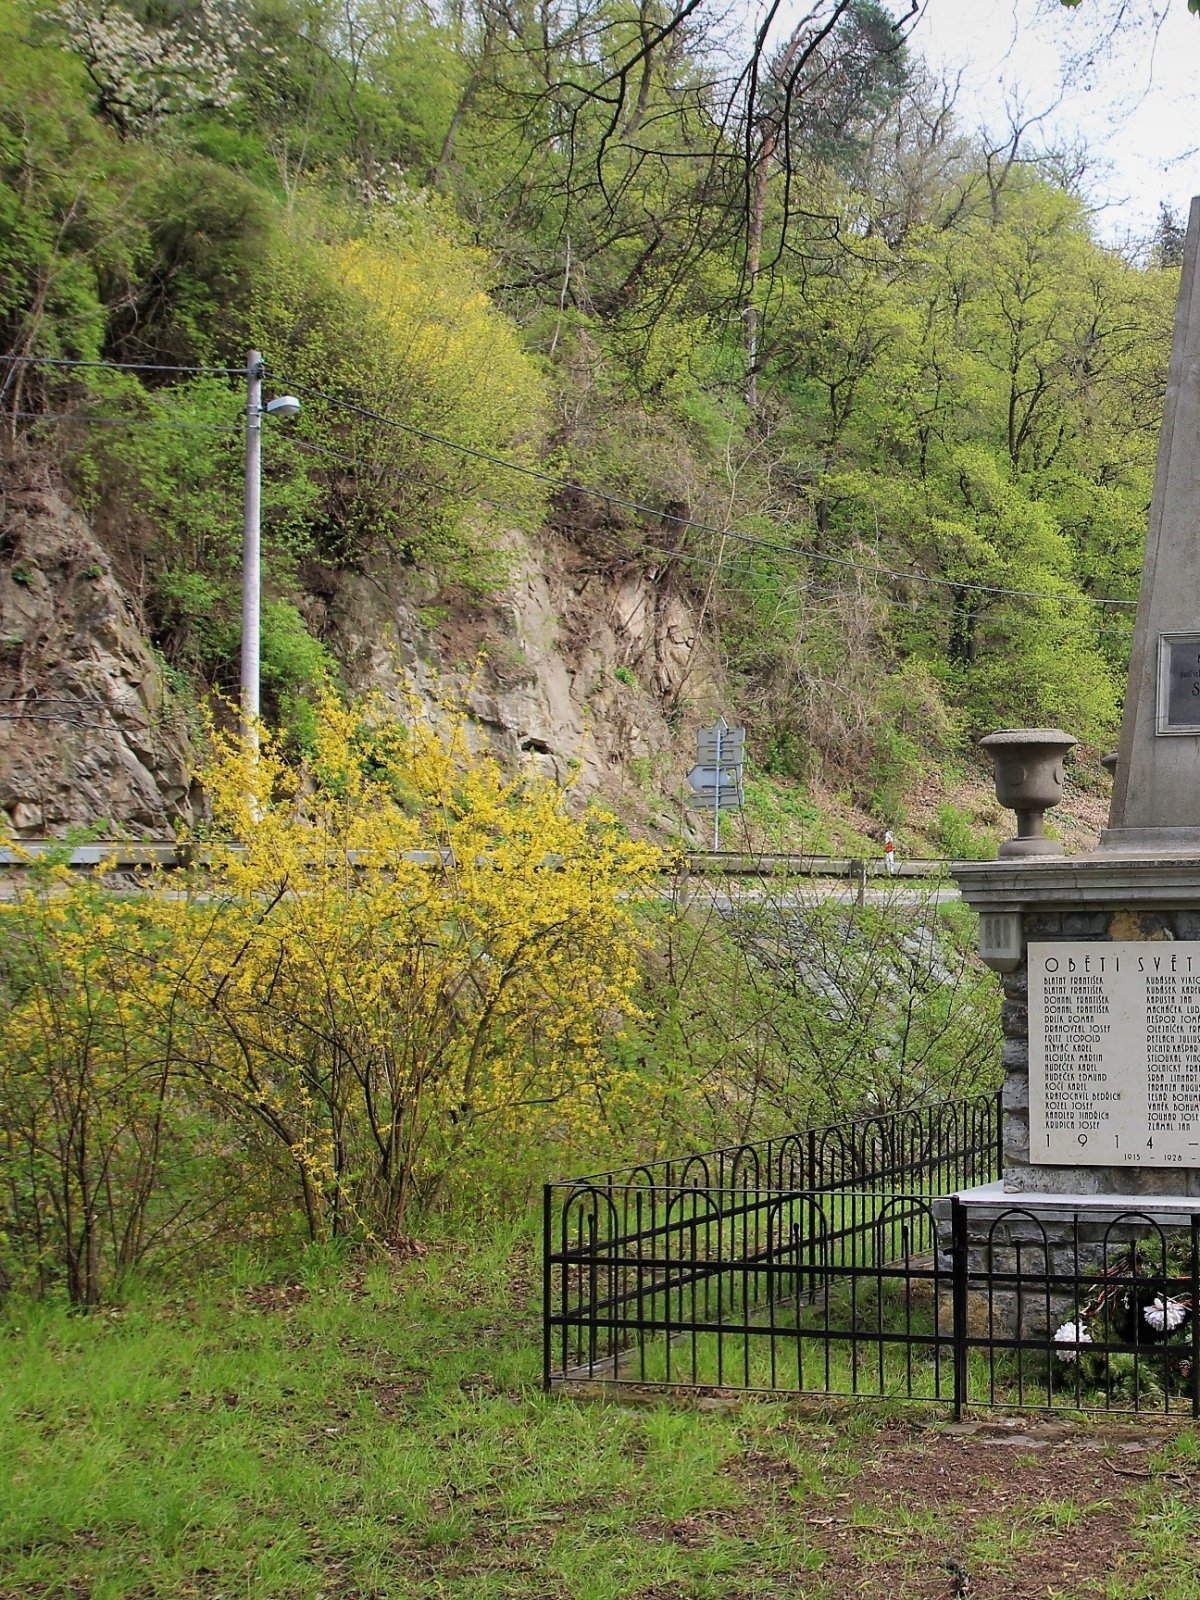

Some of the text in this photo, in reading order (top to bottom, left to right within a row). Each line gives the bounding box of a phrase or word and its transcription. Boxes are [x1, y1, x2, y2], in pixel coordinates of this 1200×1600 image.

[1045, 955, 1119, 972] OBĚTI
[1071, 976, 1103, 984] FRANTIŠEK
[1071, 986, 1103, 994] FRANTIŠEK
[1045, 995, 1109, 1004] DOHNAL FRANTIŠEK
[1147, 996, 1175, 1004] KAPUSTA
[1077, 1005, 1109, 1013] FRANTIŠEK
[1045, 1015, 1063, 1023] DRLÍK
[1147, 1015, 1175, 1023] NEŠPOR
[1147, 1024, 1184, 1033] OLEJNÍČEK
[1180, 1035, 1200, 1043] JULIUS
[1173, 1044, 1198, 1052] KAŠPAR
[1045, 1053, 1075, 1061] HLOUŠEK
[1045, 1063, 1073, 1071] HUDEČEK
[1148, 1064, 1181, 1072] SOLNICKÝ
[1045, 1072, 1074, 1081] HUDEČEK
[1045, 1092, 1120, 1100] KRATOCHVÍL BEDŘICH
[1079, 1111, 1109, 1119] JINDŘICH
[1079, 1121, 1099, 1129] JOSEF
[1046, 1133, 1154, 1150] 1914
[1124, 1153, 1141, 1161] 1915
[1164, 1154, 1182, 1162] 1928
